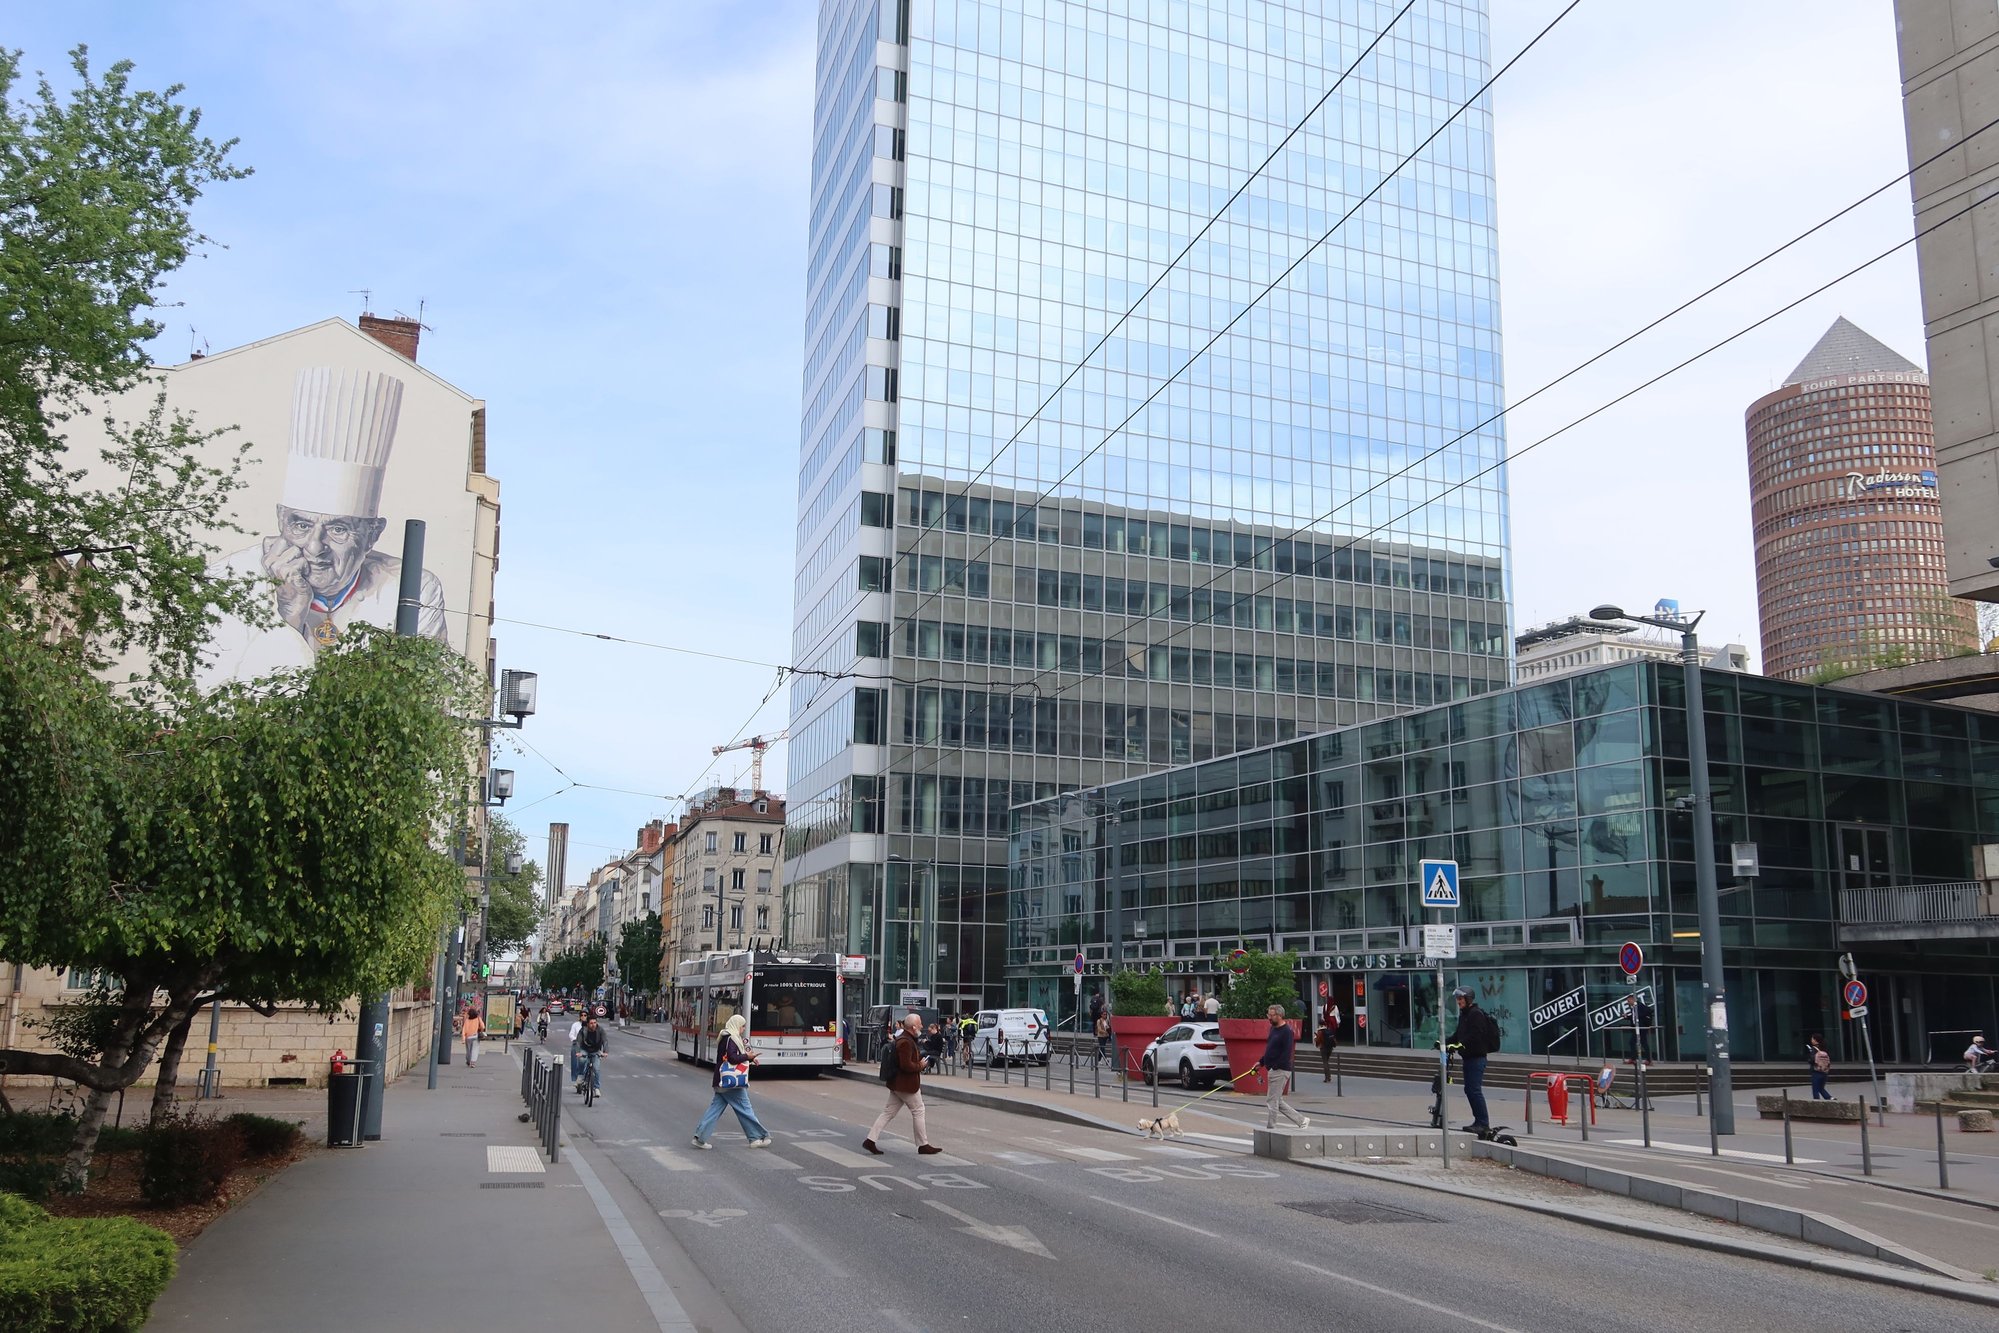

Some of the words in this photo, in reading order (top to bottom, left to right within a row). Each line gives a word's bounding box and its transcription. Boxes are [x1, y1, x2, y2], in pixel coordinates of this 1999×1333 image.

[1801, 379, 1838, 392] TOUR
[1848, 374, 1927, 384] PART-DIEU
[1846, 467, 1921, 495] Radisson
[1895, 487, 1936, 498] HOTEL
[1083, 964, 1103, 974] LES
[1123, 962, 1164, 974] ALLES
[1178, 961, 1193, 973] DE
[1324, 954, 1402, 970] BOCUSE
[1534, 991, 1580, 1025] OUVERT
[1595, 992, 1646, 1026] OUVET
[797, 1173, 992, 1192] BUS
[1083, 1163, 1281, 1183] BUS
